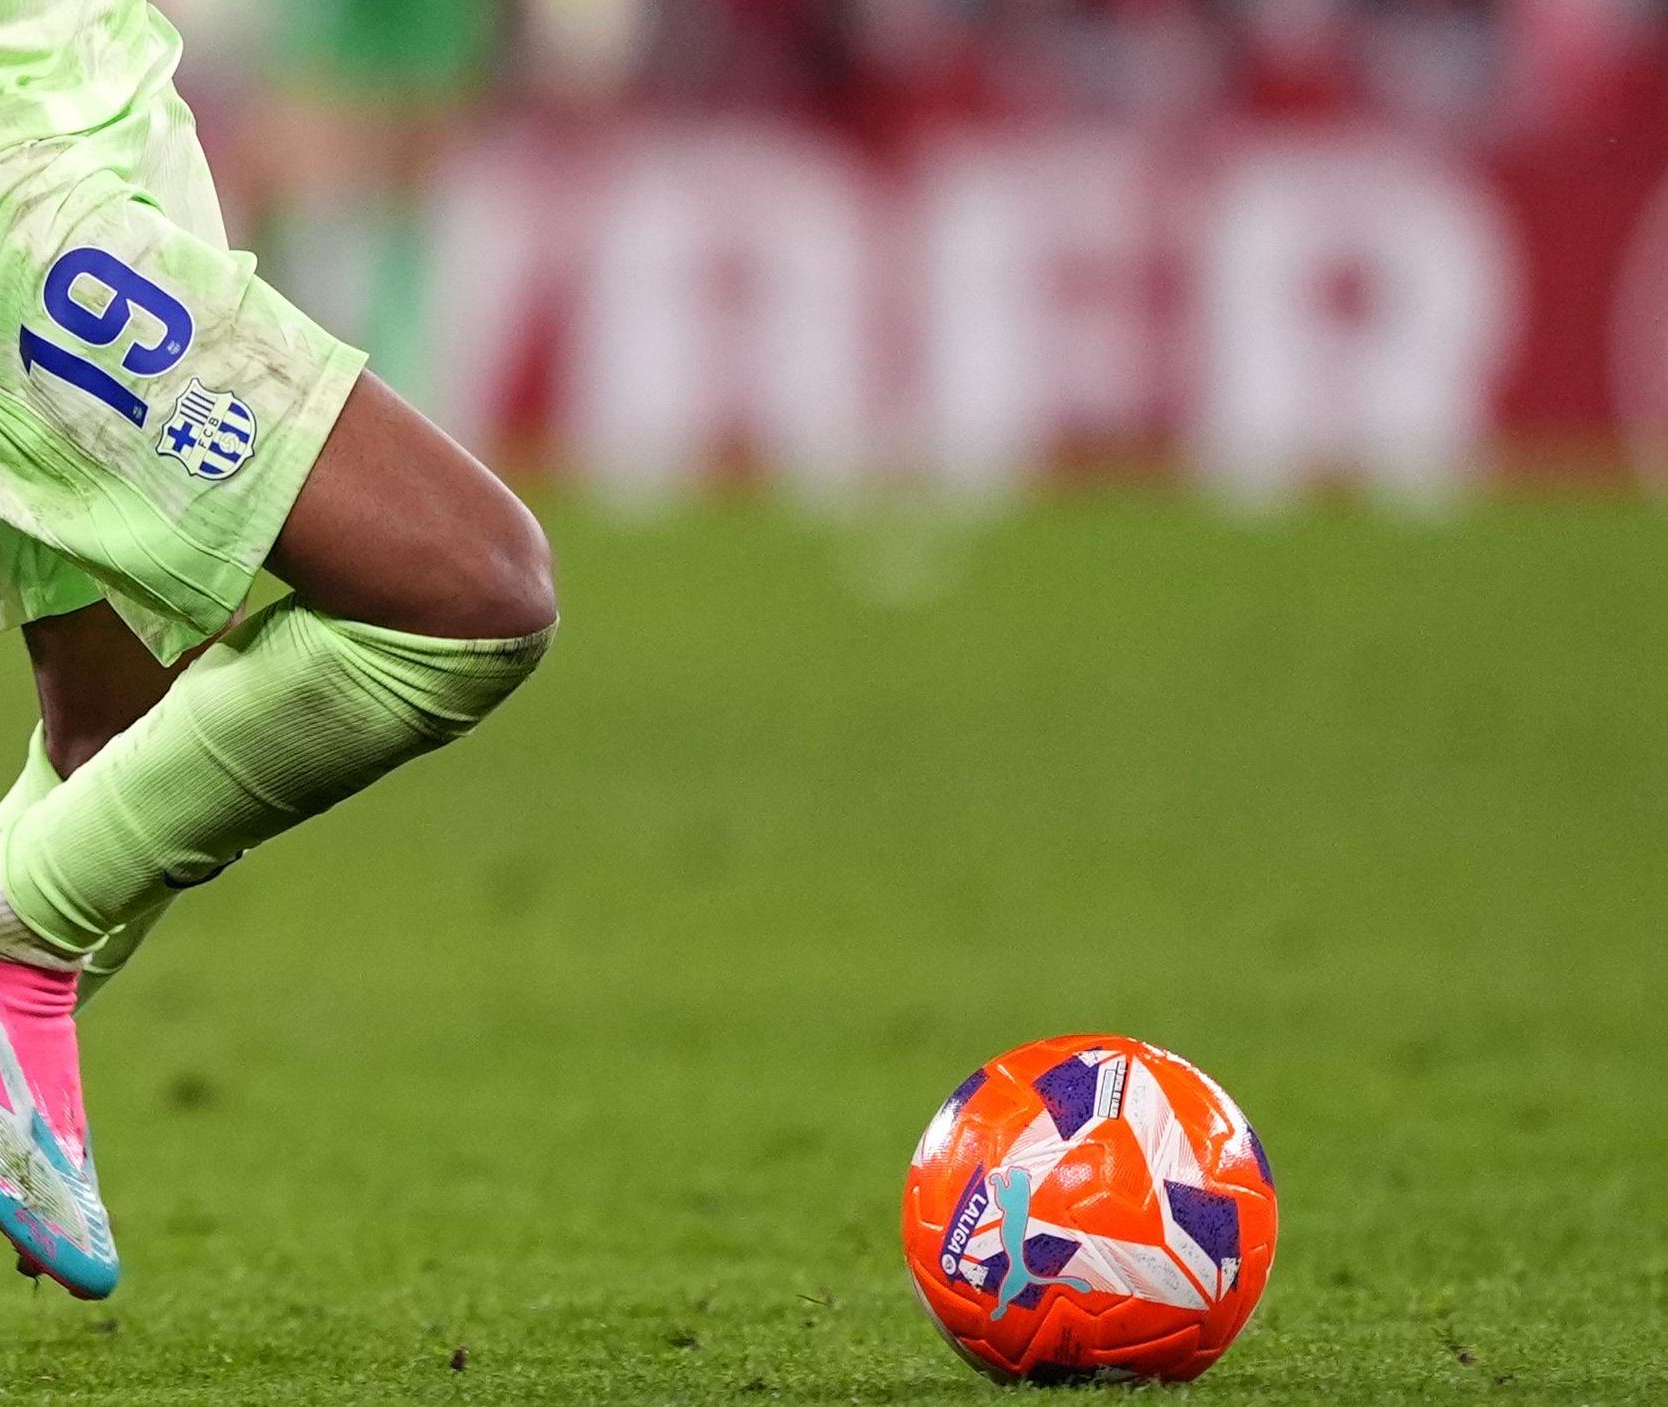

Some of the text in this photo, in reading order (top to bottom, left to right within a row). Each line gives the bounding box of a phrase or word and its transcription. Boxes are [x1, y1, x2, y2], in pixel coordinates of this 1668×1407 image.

[18, 244, 196, 431] 19
[198, 416, 220, 449] FCB
[947, 1193, 988, 1255] LALIGA
